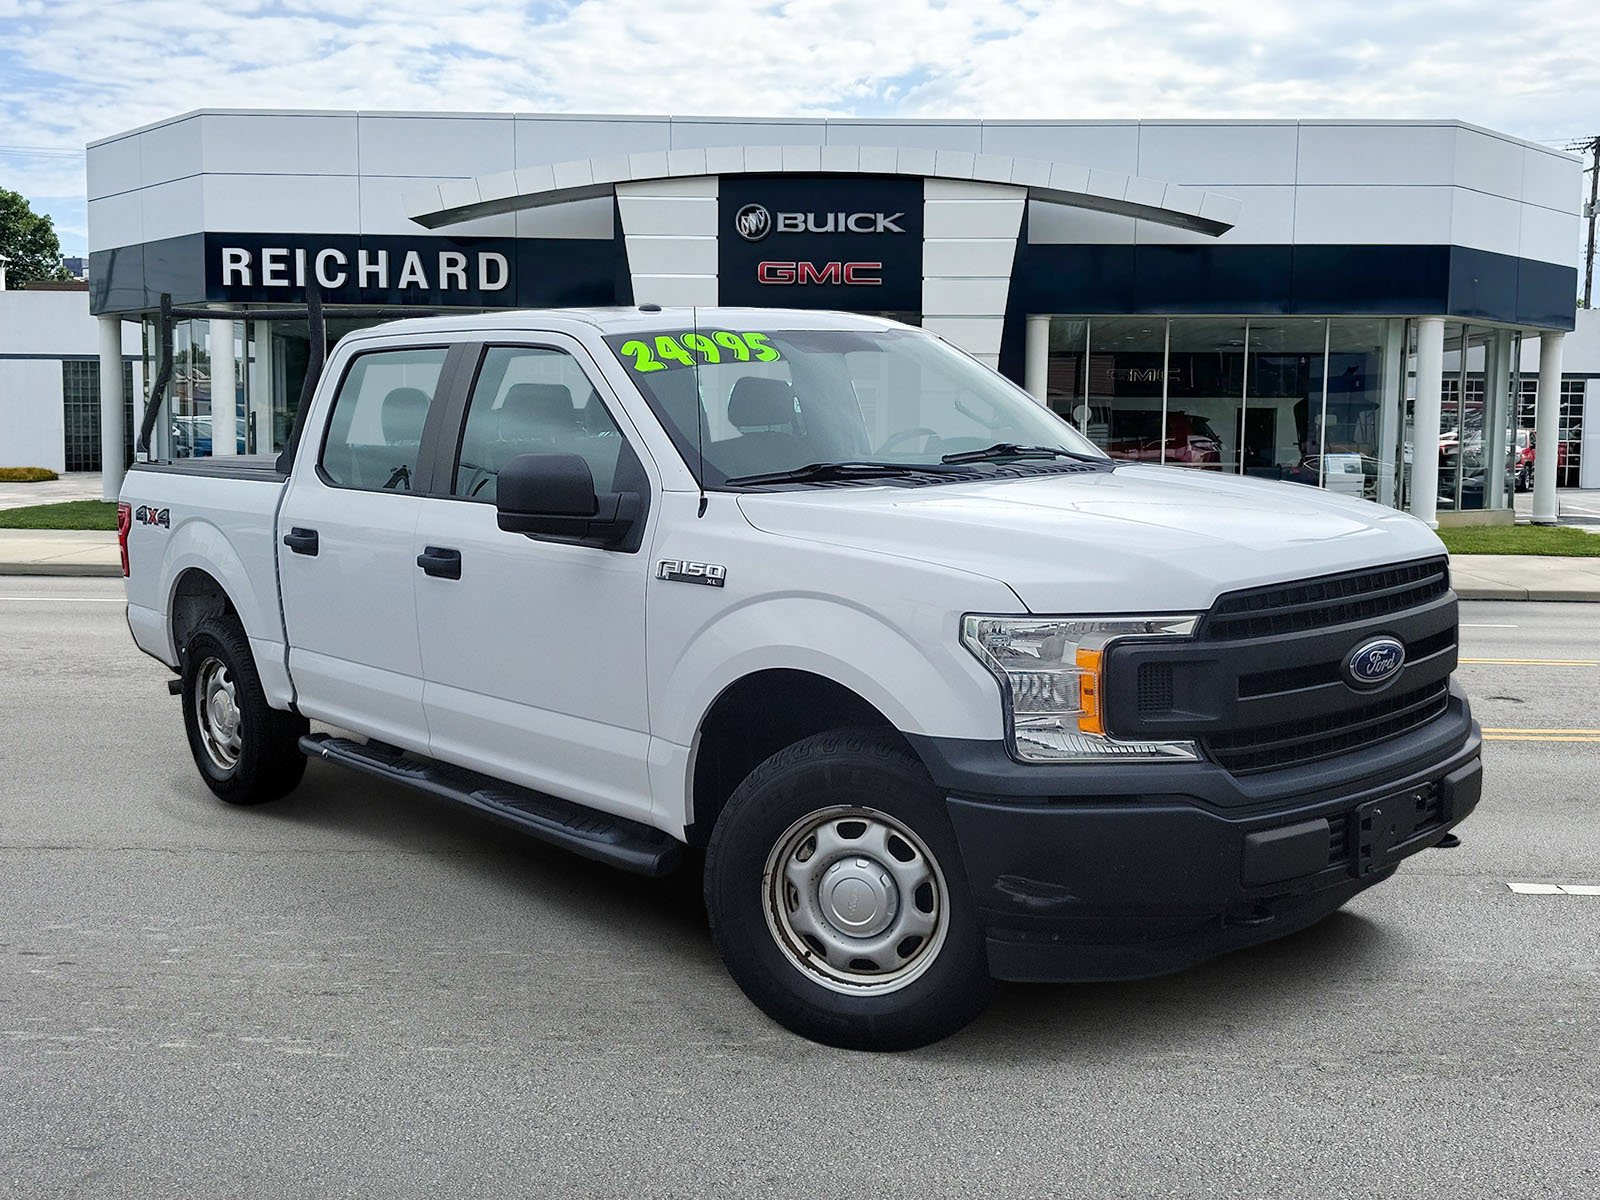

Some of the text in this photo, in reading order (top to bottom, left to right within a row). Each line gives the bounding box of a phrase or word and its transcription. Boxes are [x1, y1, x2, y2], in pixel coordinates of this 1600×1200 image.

[776, 212, 906, 233] BUICK
[222, 247, 509, 290] REICHARD
[758, 261, 882, 285] GMC
[620, 330, 781, 372] 24995
[1106, 368, 1181, 382] GMC
[1366, 649, 1396, 675] Ford
